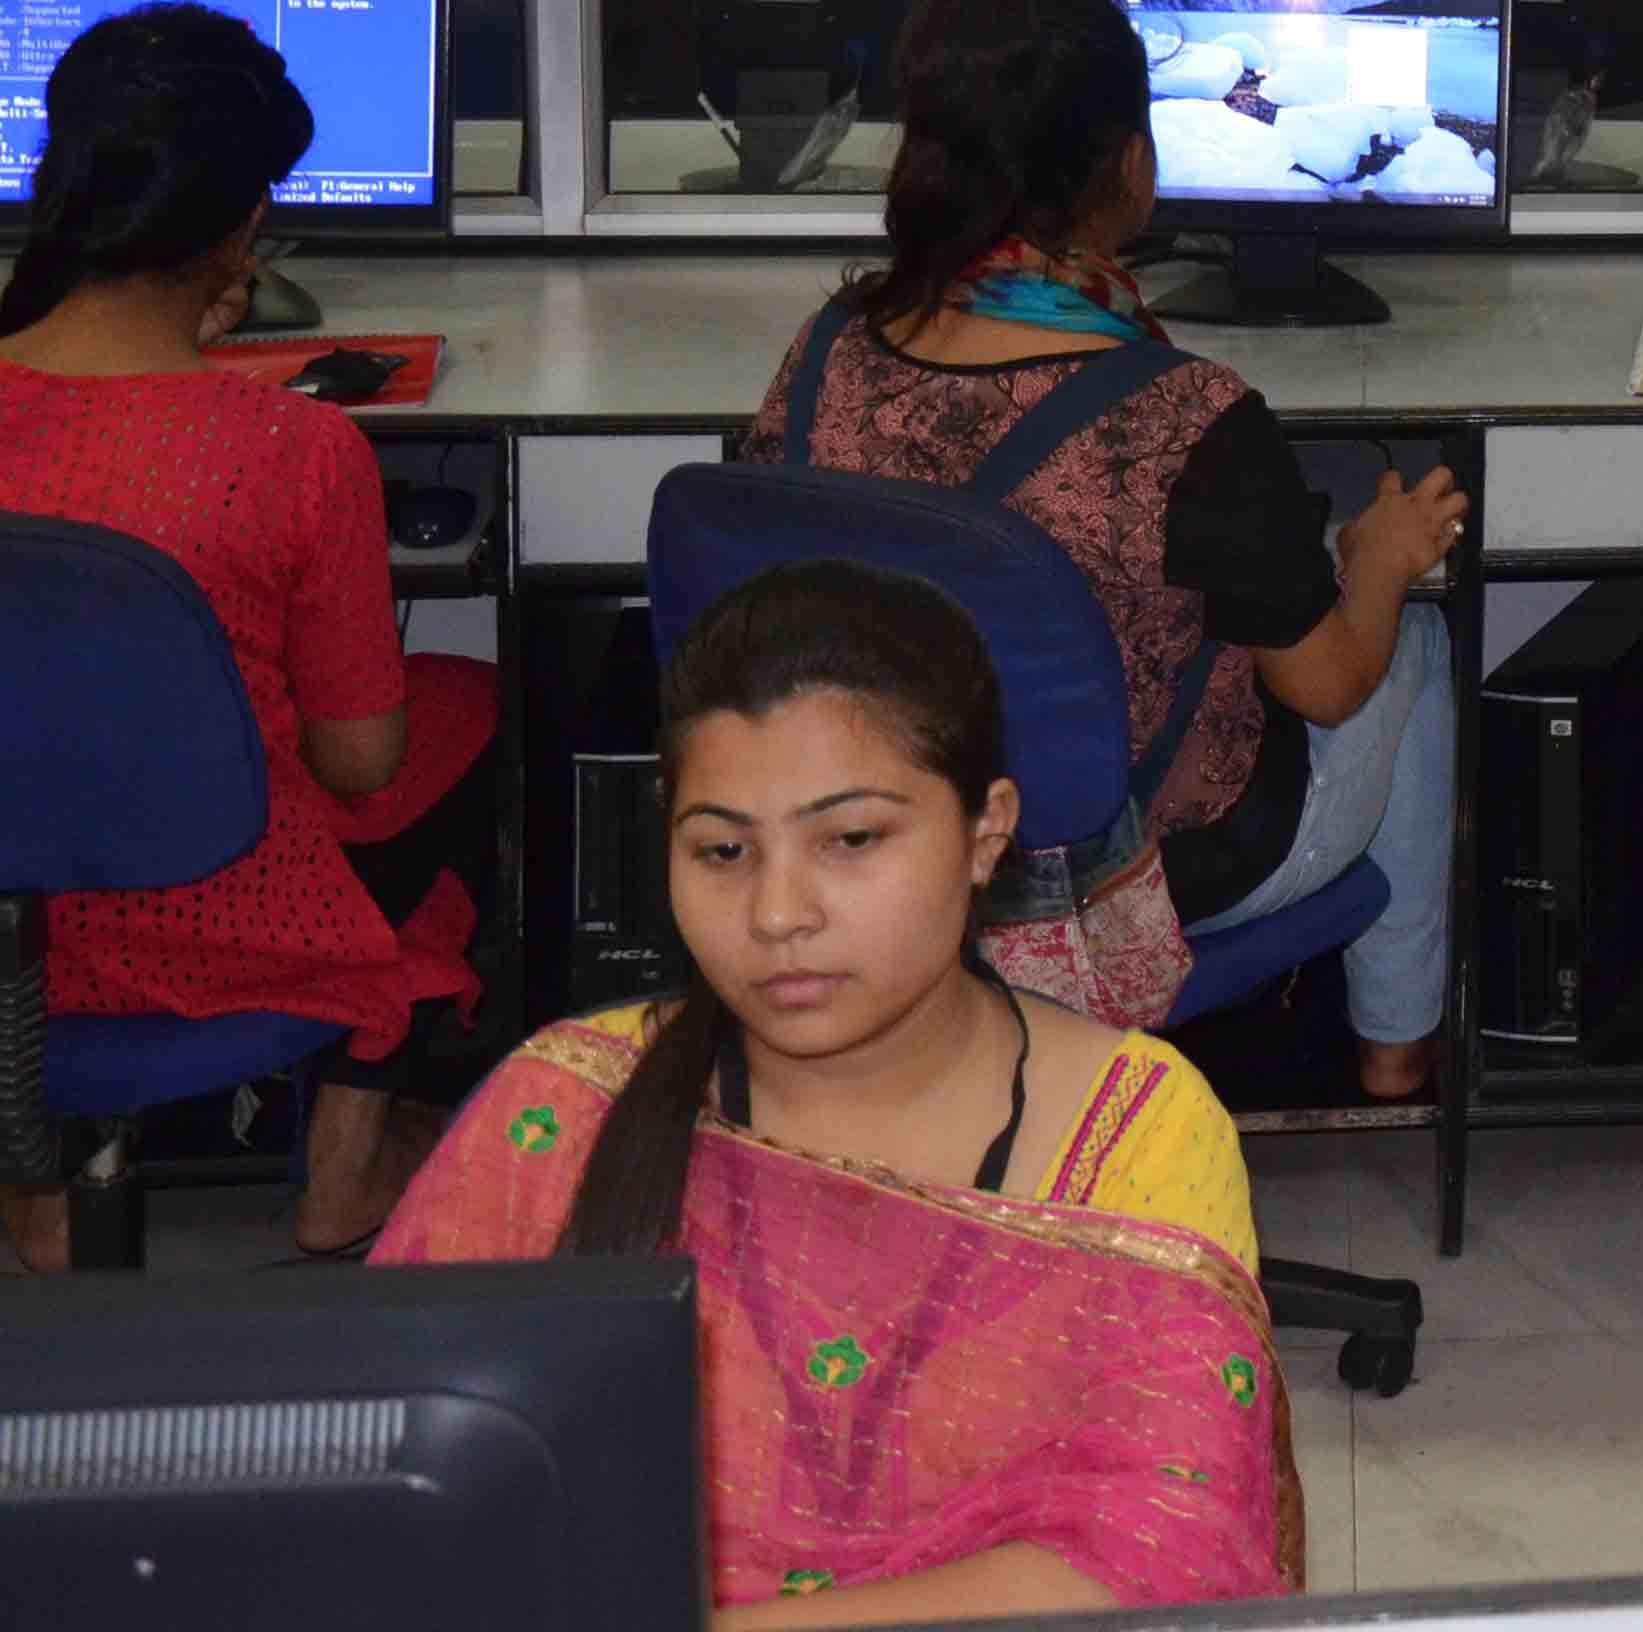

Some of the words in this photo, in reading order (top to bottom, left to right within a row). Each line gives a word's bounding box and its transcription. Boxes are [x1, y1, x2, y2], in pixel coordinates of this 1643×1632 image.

[287, 0, 302, 9] to
[306, 0, 326, 9] the
[389, 181, 416, 194] Help
[597, 949, 662, 960] HCL
